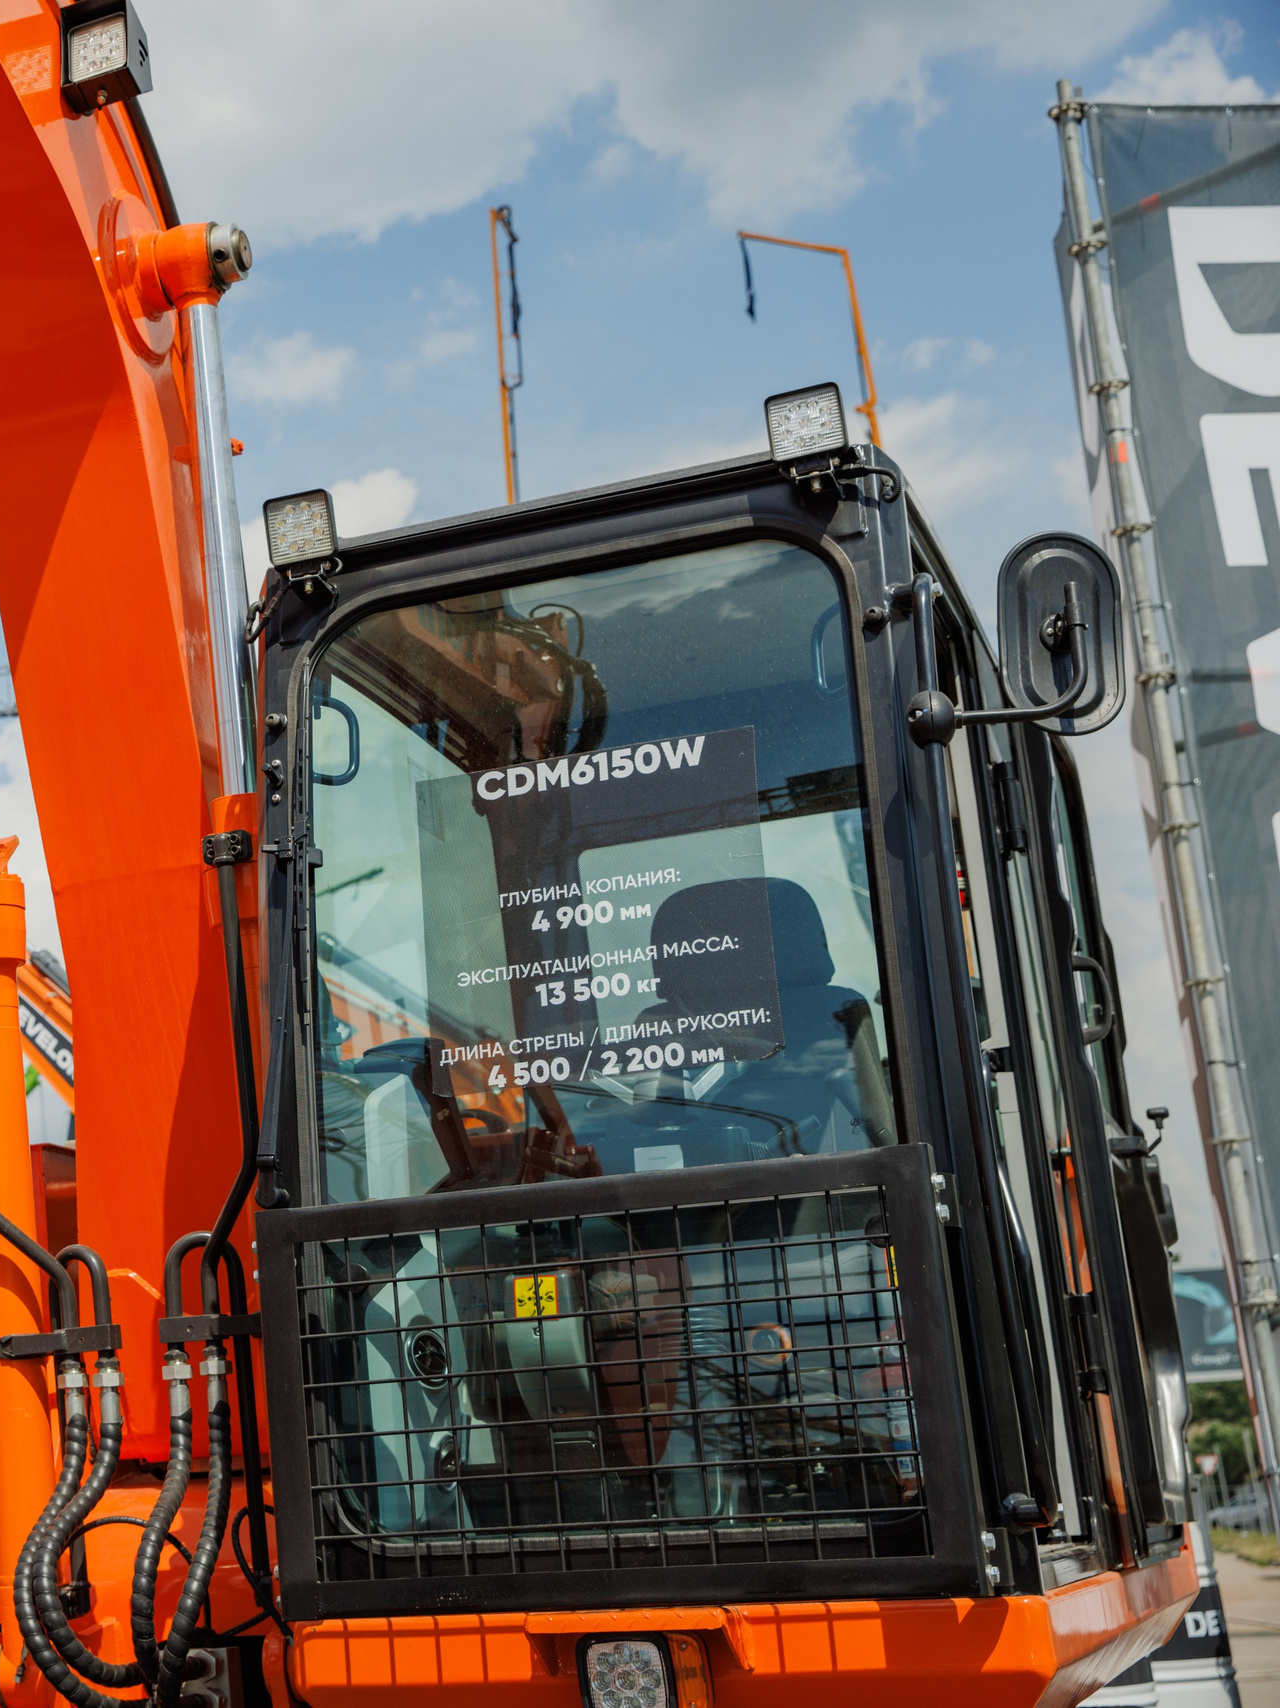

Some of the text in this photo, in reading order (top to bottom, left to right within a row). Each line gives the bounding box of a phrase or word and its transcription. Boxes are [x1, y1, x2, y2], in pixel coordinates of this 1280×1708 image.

[476, 735, 706, 801] CDM6150W
[499, 867, 681, 908] ГЛУБИНА КОПАНИЯ:
[531, 900, 652, 932] 4 900 мм
[457, 935, 740, 987] ЭКСПЛУАТАЦИОННАЯ МАССА:
[534, 972, 661, 1007] 13 500 кг
[439, 1042, 505, 1067] ДЛИНА
[508, 1031, 584, 1055] СТРЕЛЫ
[604, 1020, 673, 1045] ДЛИНА
[677, 1007, 772, 1034] РУКОЯТИ:
[487, 1064, 507, 1088] 4
[513, 1056, 571, 1086] 500
[600, 1050, 620, 1076] 2
[625, 1042, 685, 1072] 200
[691, 1046, 725, 1065] мм
[1185, 1609, 1226, 1638] DE
